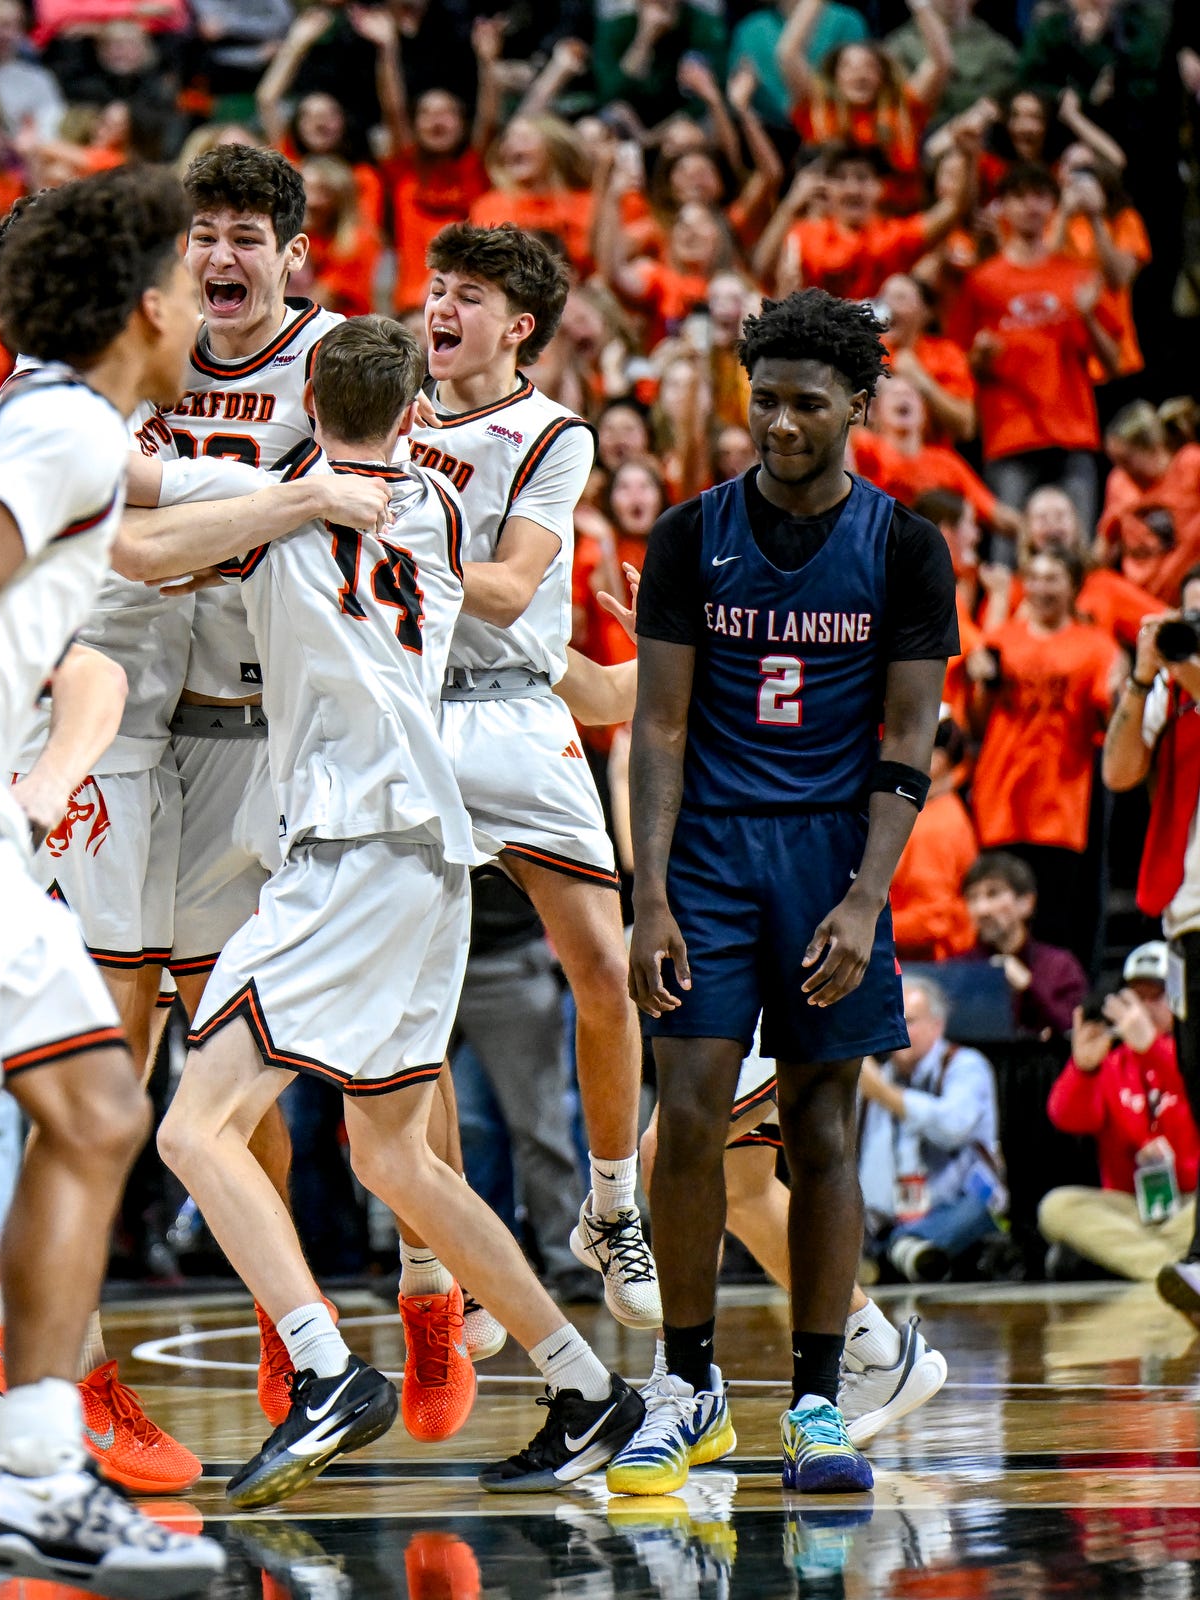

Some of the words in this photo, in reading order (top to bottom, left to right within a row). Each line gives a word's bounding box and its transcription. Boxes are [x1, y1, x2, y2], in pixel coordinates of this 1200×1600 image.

[161, 391, 277, 422] CKFORD
[324, 518, 426, 657] 14
[703, 602, 759, 640] EAST
[766, 610, 872, 643] LANSING
[756, 653, 806, 727] 2
